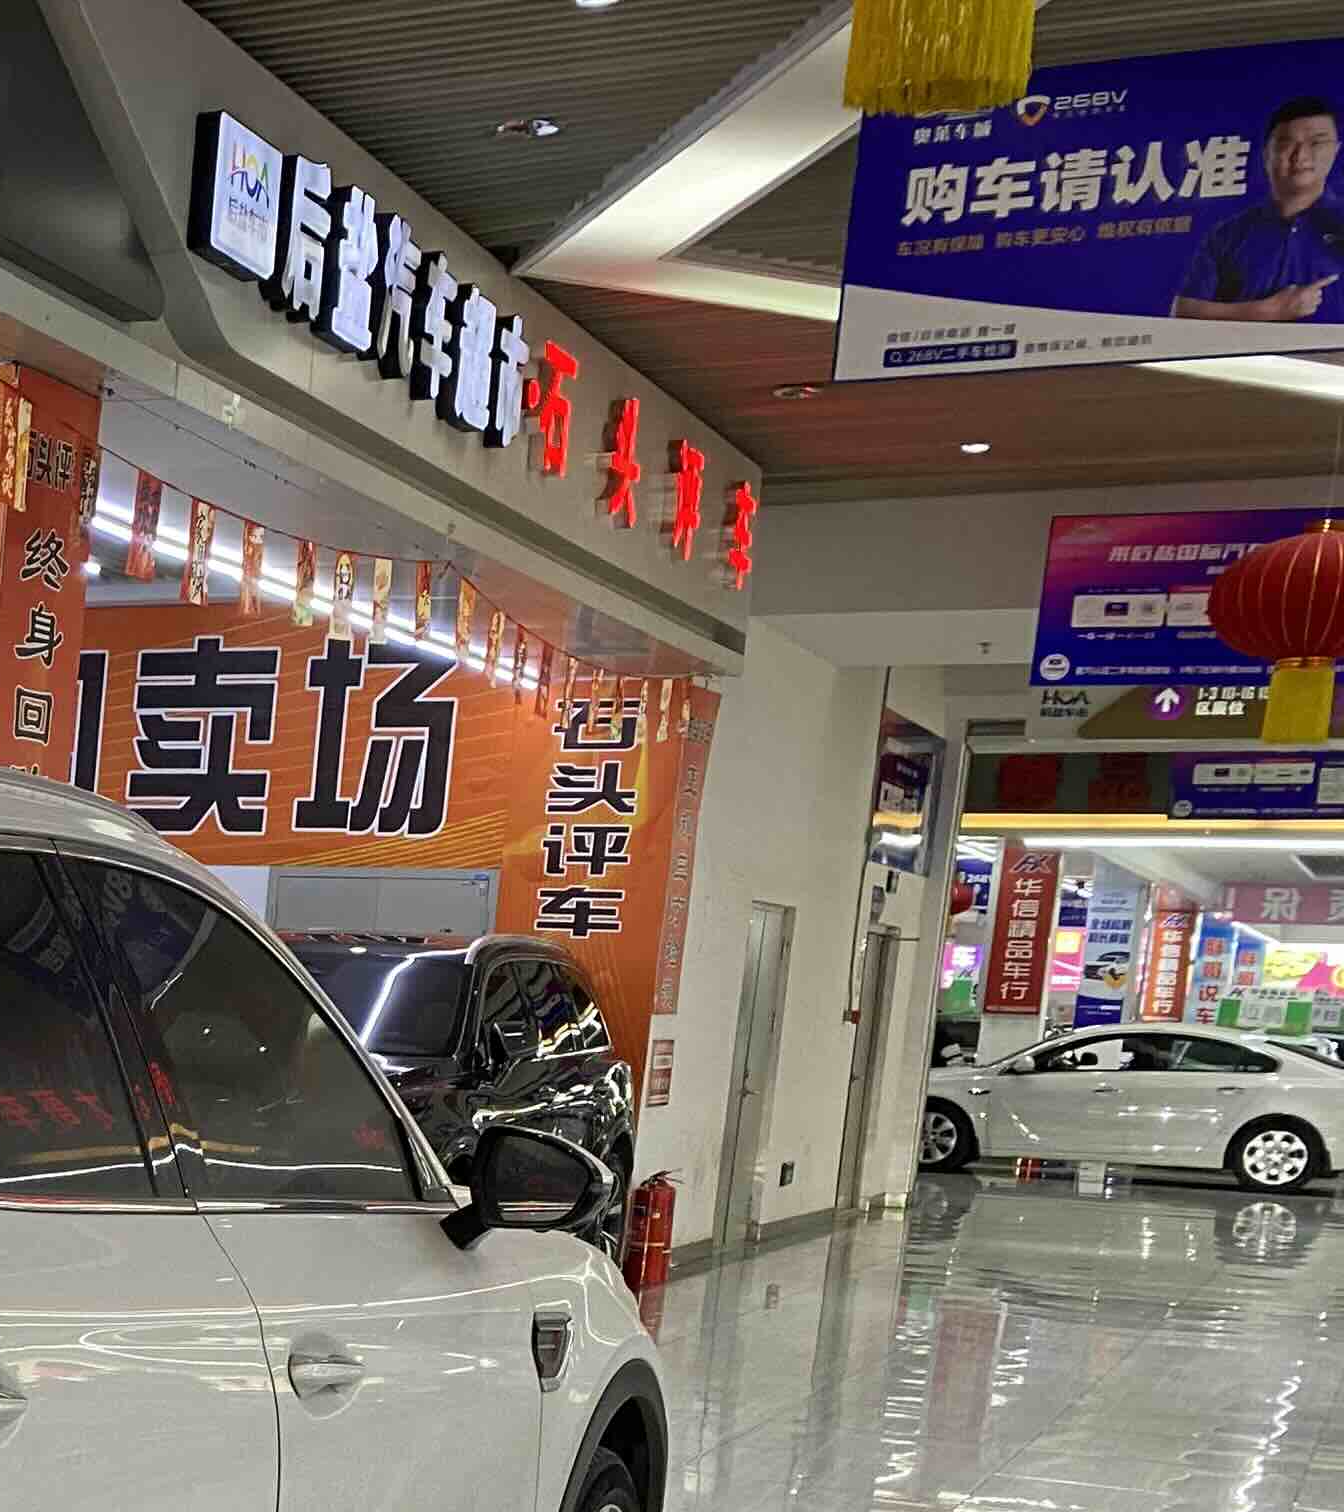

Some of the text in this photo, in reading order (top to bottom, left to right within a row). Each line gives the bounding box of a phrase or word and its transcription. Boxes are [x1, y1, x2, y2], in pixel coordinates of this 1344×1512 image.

[1053, 88, 1128, 110] 268V
[899, 136, 1252, 227] 购车请认准
[534, 695, 640, 939] 石头评车
[1000, 878, 1045, 1001] 华信精品车行
